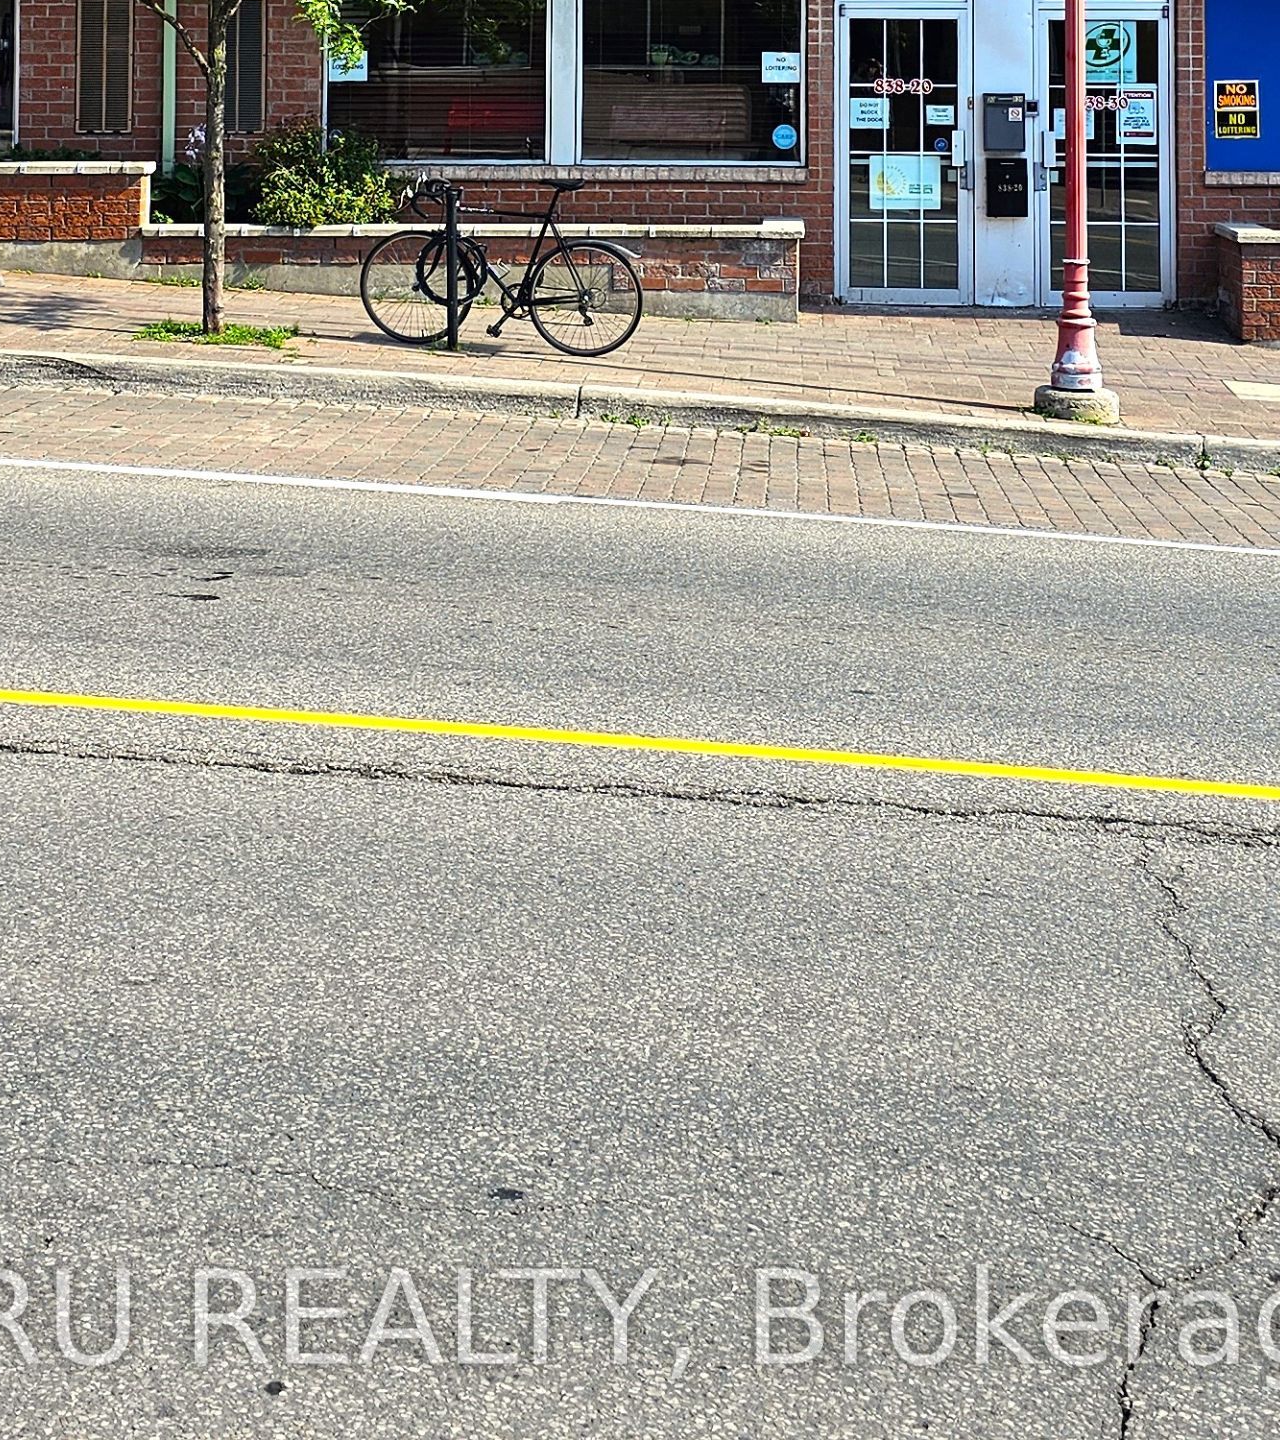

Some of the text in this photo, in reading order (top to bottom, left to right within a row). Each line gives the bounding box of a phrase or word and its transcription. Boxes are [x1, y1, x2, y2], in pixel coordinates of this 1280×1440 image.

[873, 78, 934, 94] 838-20
[1225, 83, 1248, 95] NO
[1085, 95, 1129, 110] 38-30
[1218, 95, 1256, 106] SMOKING
[1228, 113, 1246, 125] NO
[1218, 126, 1256, 134] LOITERING
